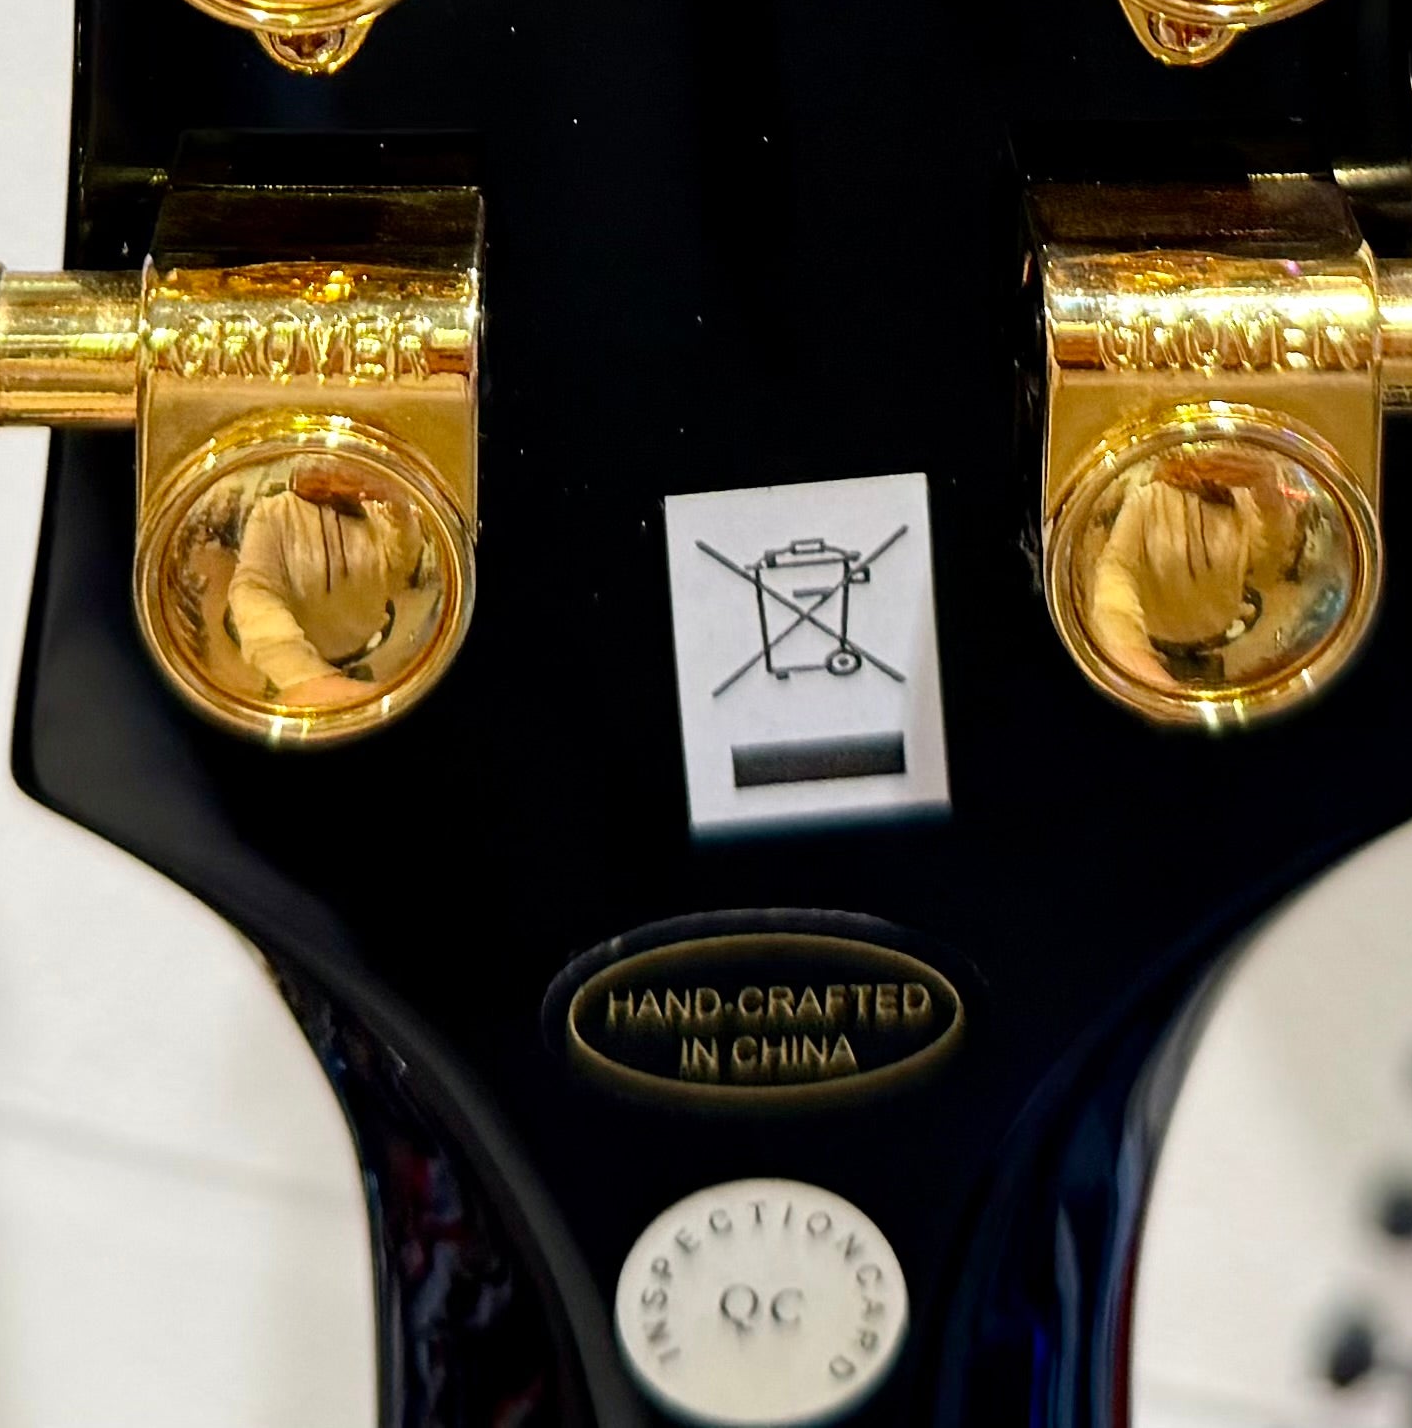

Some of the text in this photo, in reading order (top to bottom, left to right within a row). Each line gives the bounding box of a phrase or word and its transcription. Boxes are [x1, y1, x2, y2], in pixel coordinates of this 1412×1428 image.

[169, 310, 431, 384] GROVER
[680, 1033, 860, 1080] IN CHINA
[720, 1283, 804, 1337] QC
